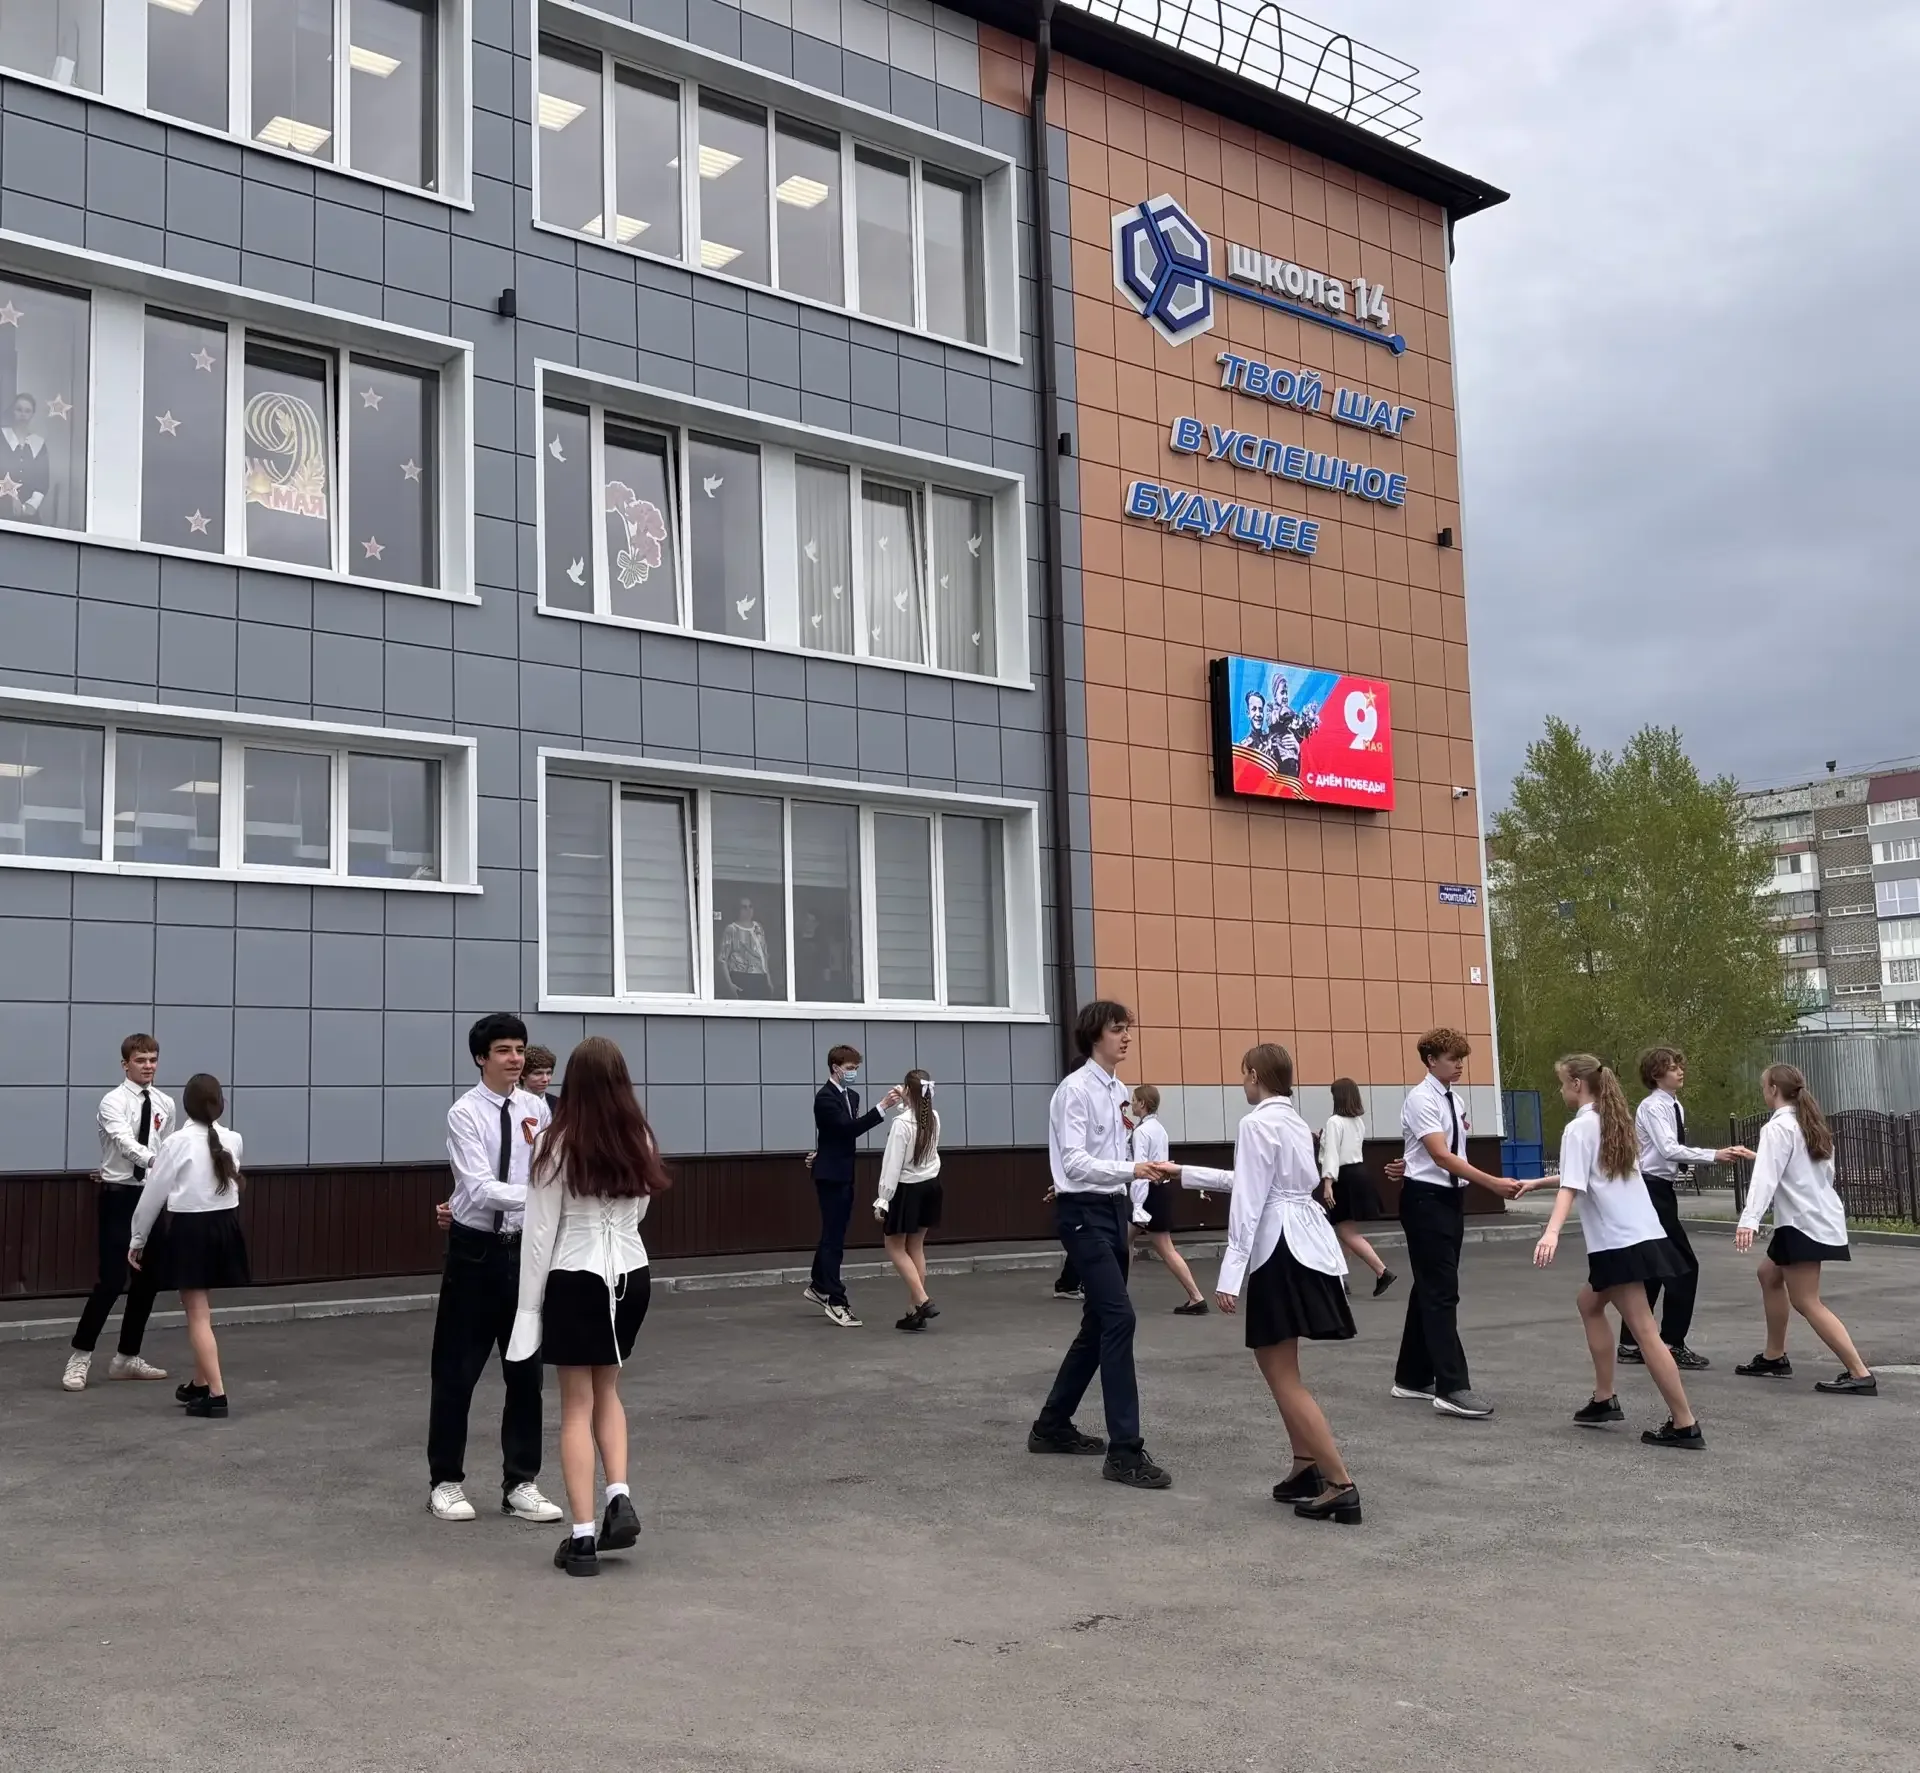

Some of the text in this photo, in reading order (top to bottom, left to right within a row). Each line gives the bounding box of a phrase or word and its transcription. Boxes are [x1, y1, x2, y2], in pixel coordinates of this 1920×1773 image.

[1228, 243, 1390, 328] школа 14
[1217, 352, 1416, 436] ТВОЙ ШАГ
[1170, 416, 1408, 508] В УСПЕШНОЕ
[272, 486, 325, 517] МАЯ
[1125, 481, 1320, 556] БУДУЩЕЕ
[1344, 690, 1378, 750] 9
[1363, 739, 1384, 753] МАЯ
[1306, 773, 1314, 784] С
[1315, 773, 1342, 788] ДНЁМ
[1466, 889, 1477, 904] 25
